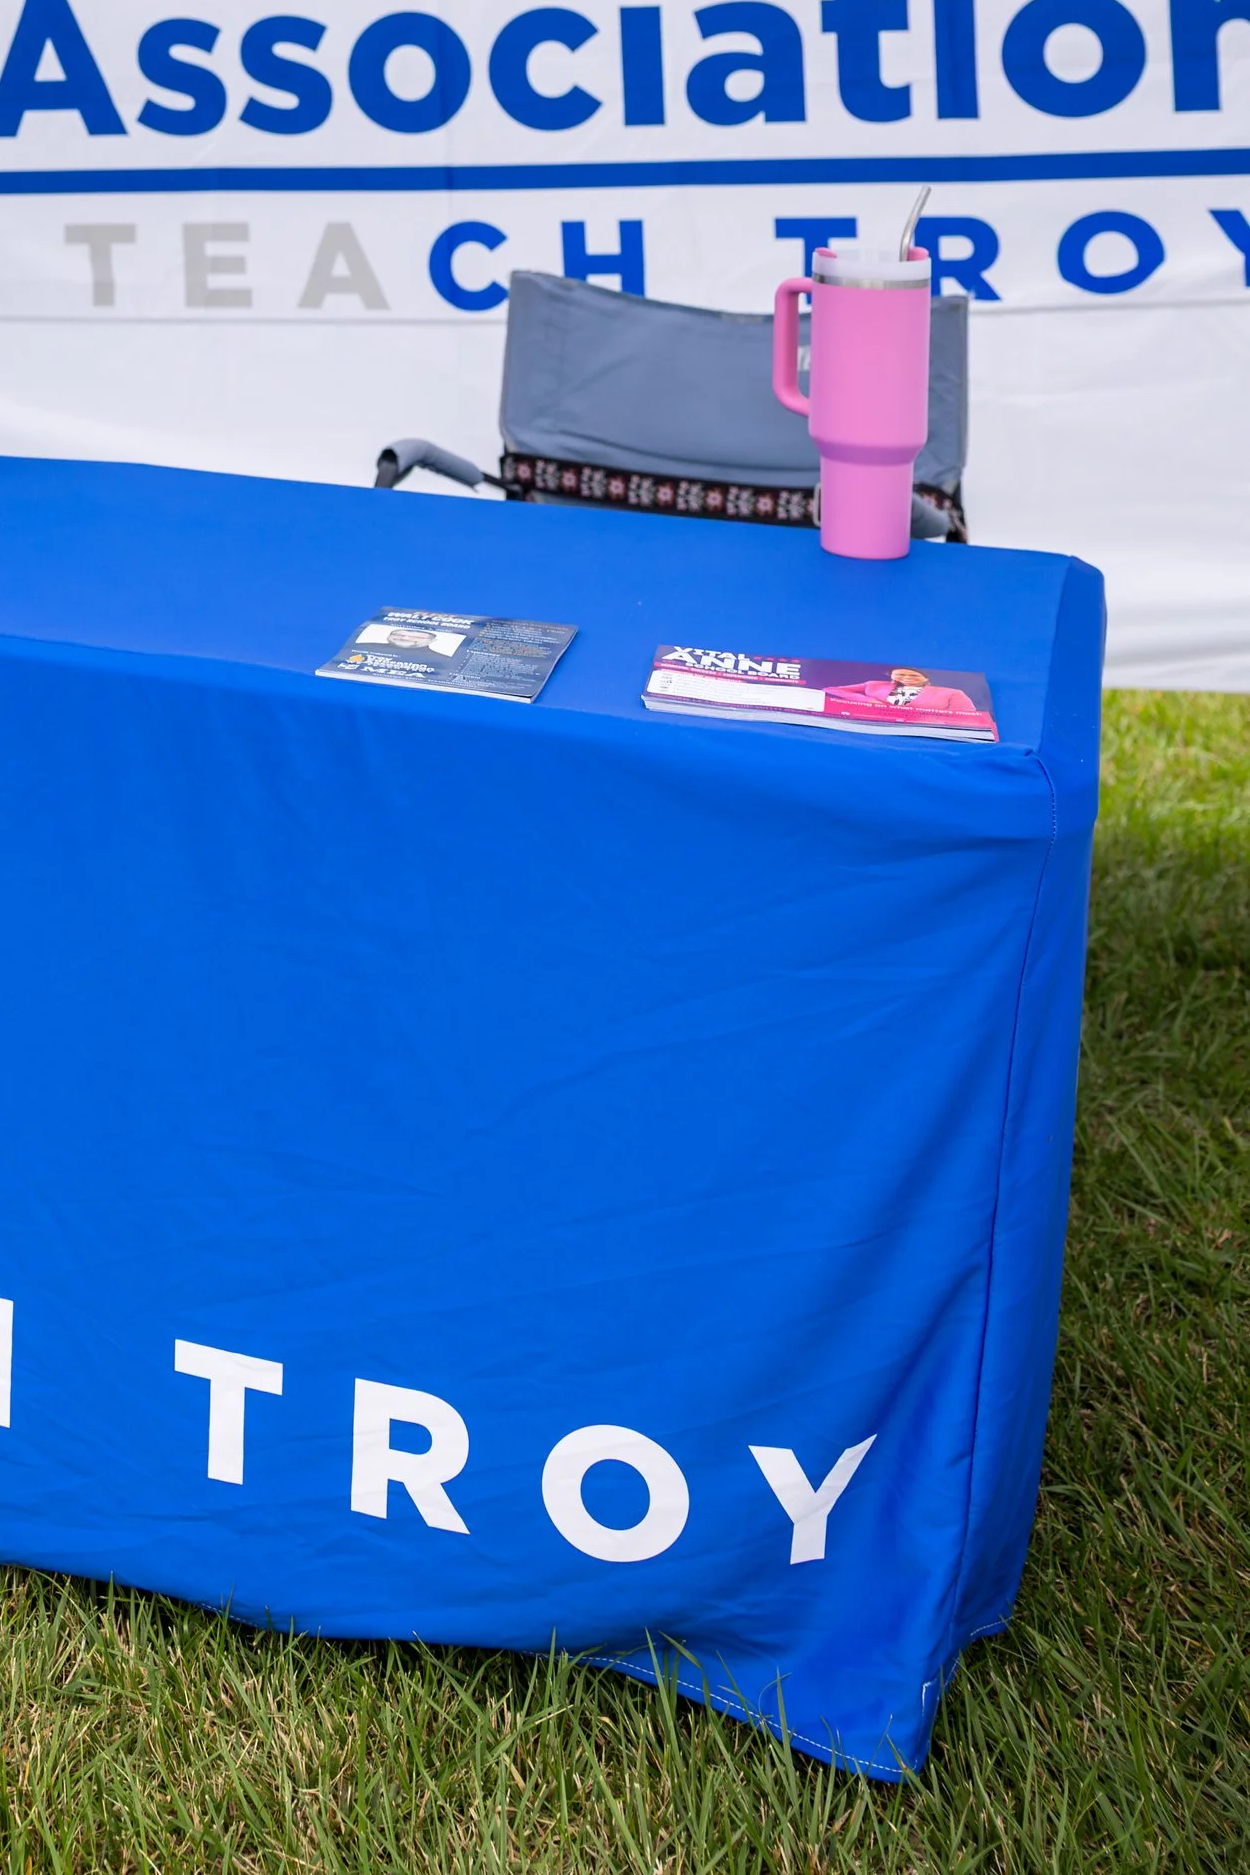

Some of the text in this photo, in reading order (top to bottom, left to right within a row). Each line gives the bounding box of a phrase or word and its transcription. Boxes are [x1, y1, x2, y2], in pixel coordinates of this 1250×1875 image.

[64, 219, 646, 312] TEACH
[662, 651, 801, 676] ANNE
[685, 662, 746, 674] SCHOOL
[174, 1338, 878, 1565] TROY
